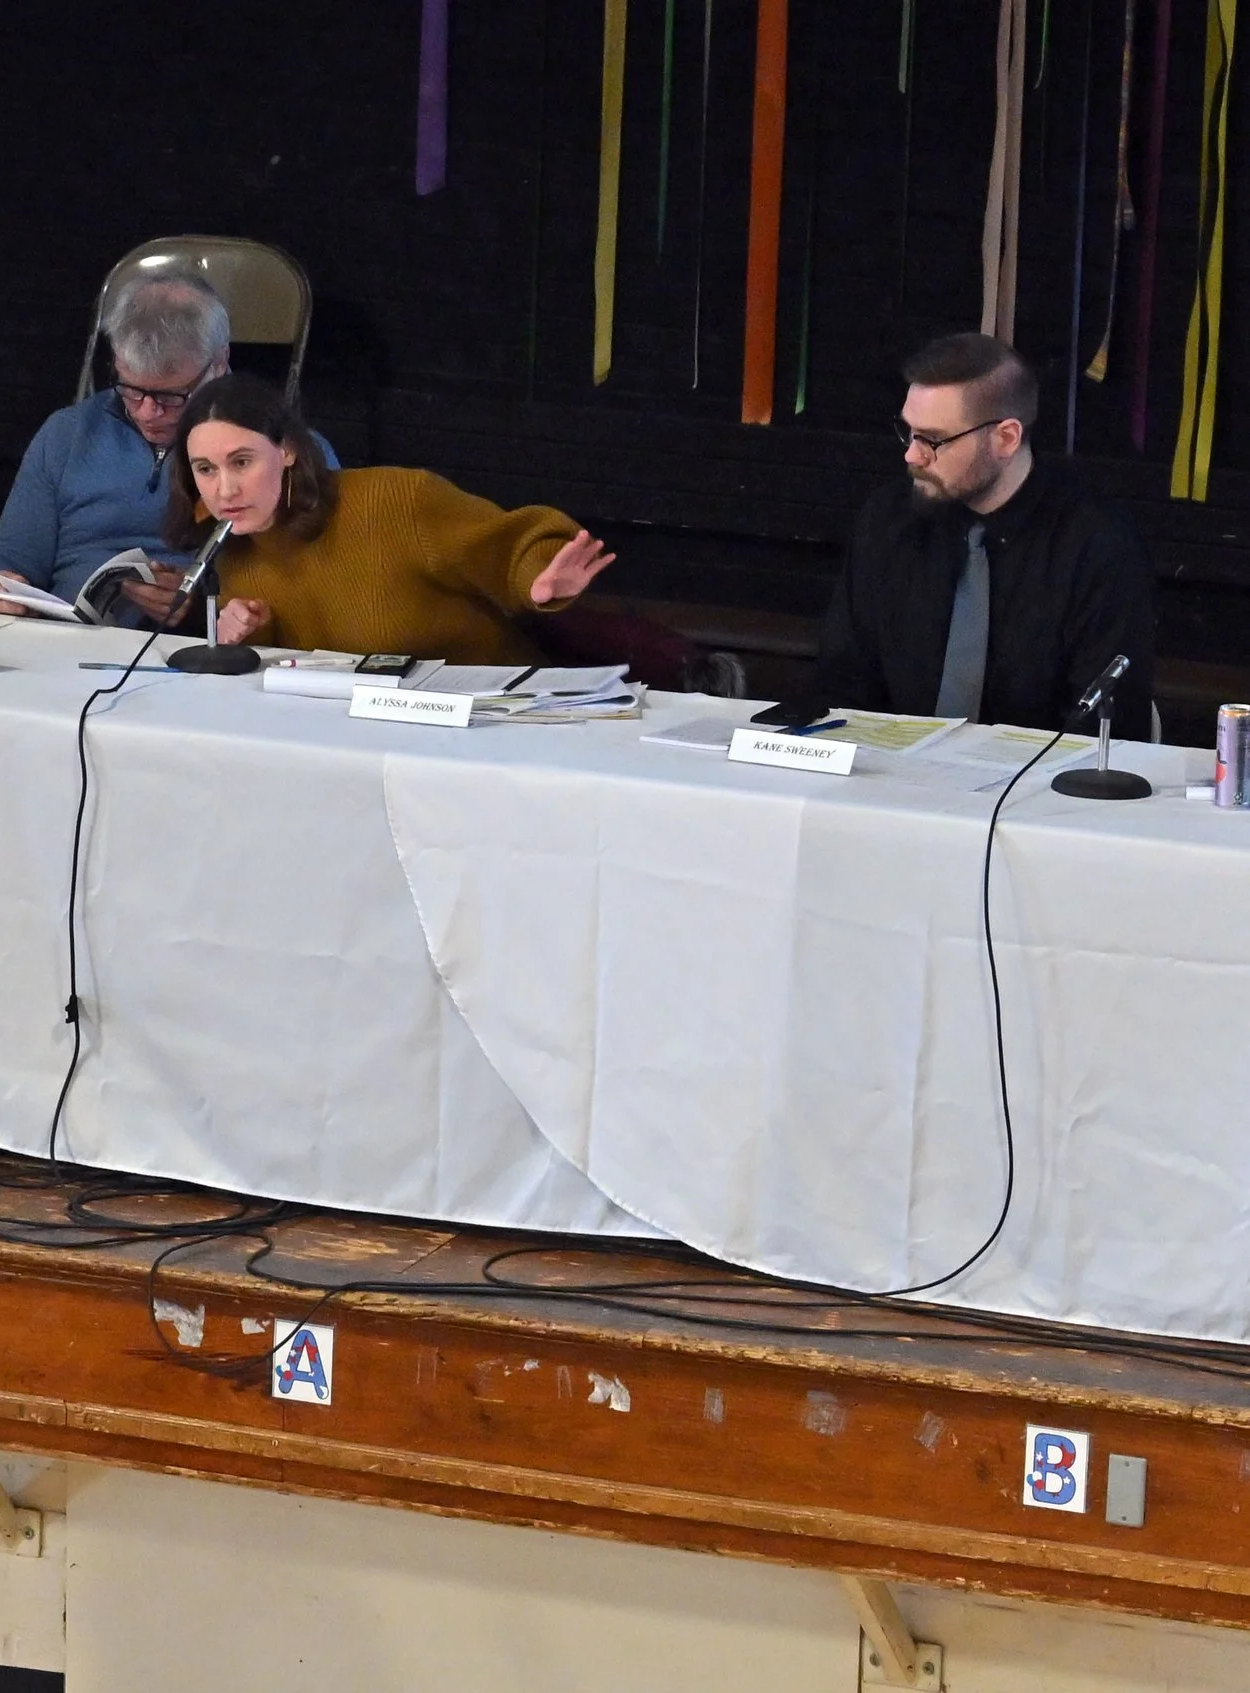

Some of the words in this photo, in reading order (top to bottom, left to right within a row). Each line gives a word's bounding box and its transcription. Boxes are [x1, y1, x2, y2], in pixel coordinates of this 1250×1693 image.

[369, 697, 408, 709] ALYSSA
[410, 701, 456, 713] JOHNSON
[753, 740, 783, 753] KANE
[784, 744, 836, 759] SWEENEY
[277, 1329, 330, 1400] A
[1029, 1432, 1077, 1506] B
